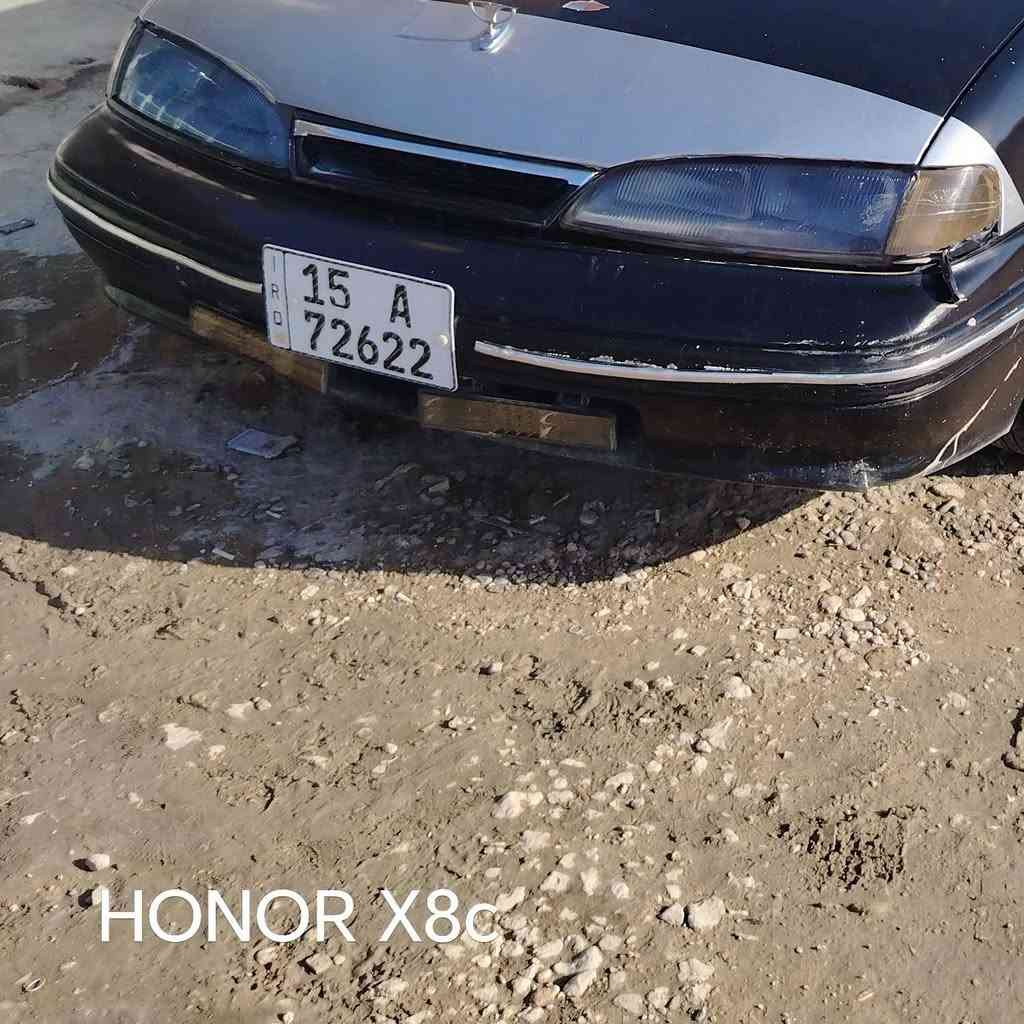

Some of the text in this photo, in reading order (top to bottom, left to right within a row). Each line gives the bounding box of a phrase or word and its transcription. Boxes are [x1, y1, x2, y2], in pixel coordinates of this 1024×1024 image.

[302, 263, 412, 329] 15 A
[303, 309, 434, 381] 72622
